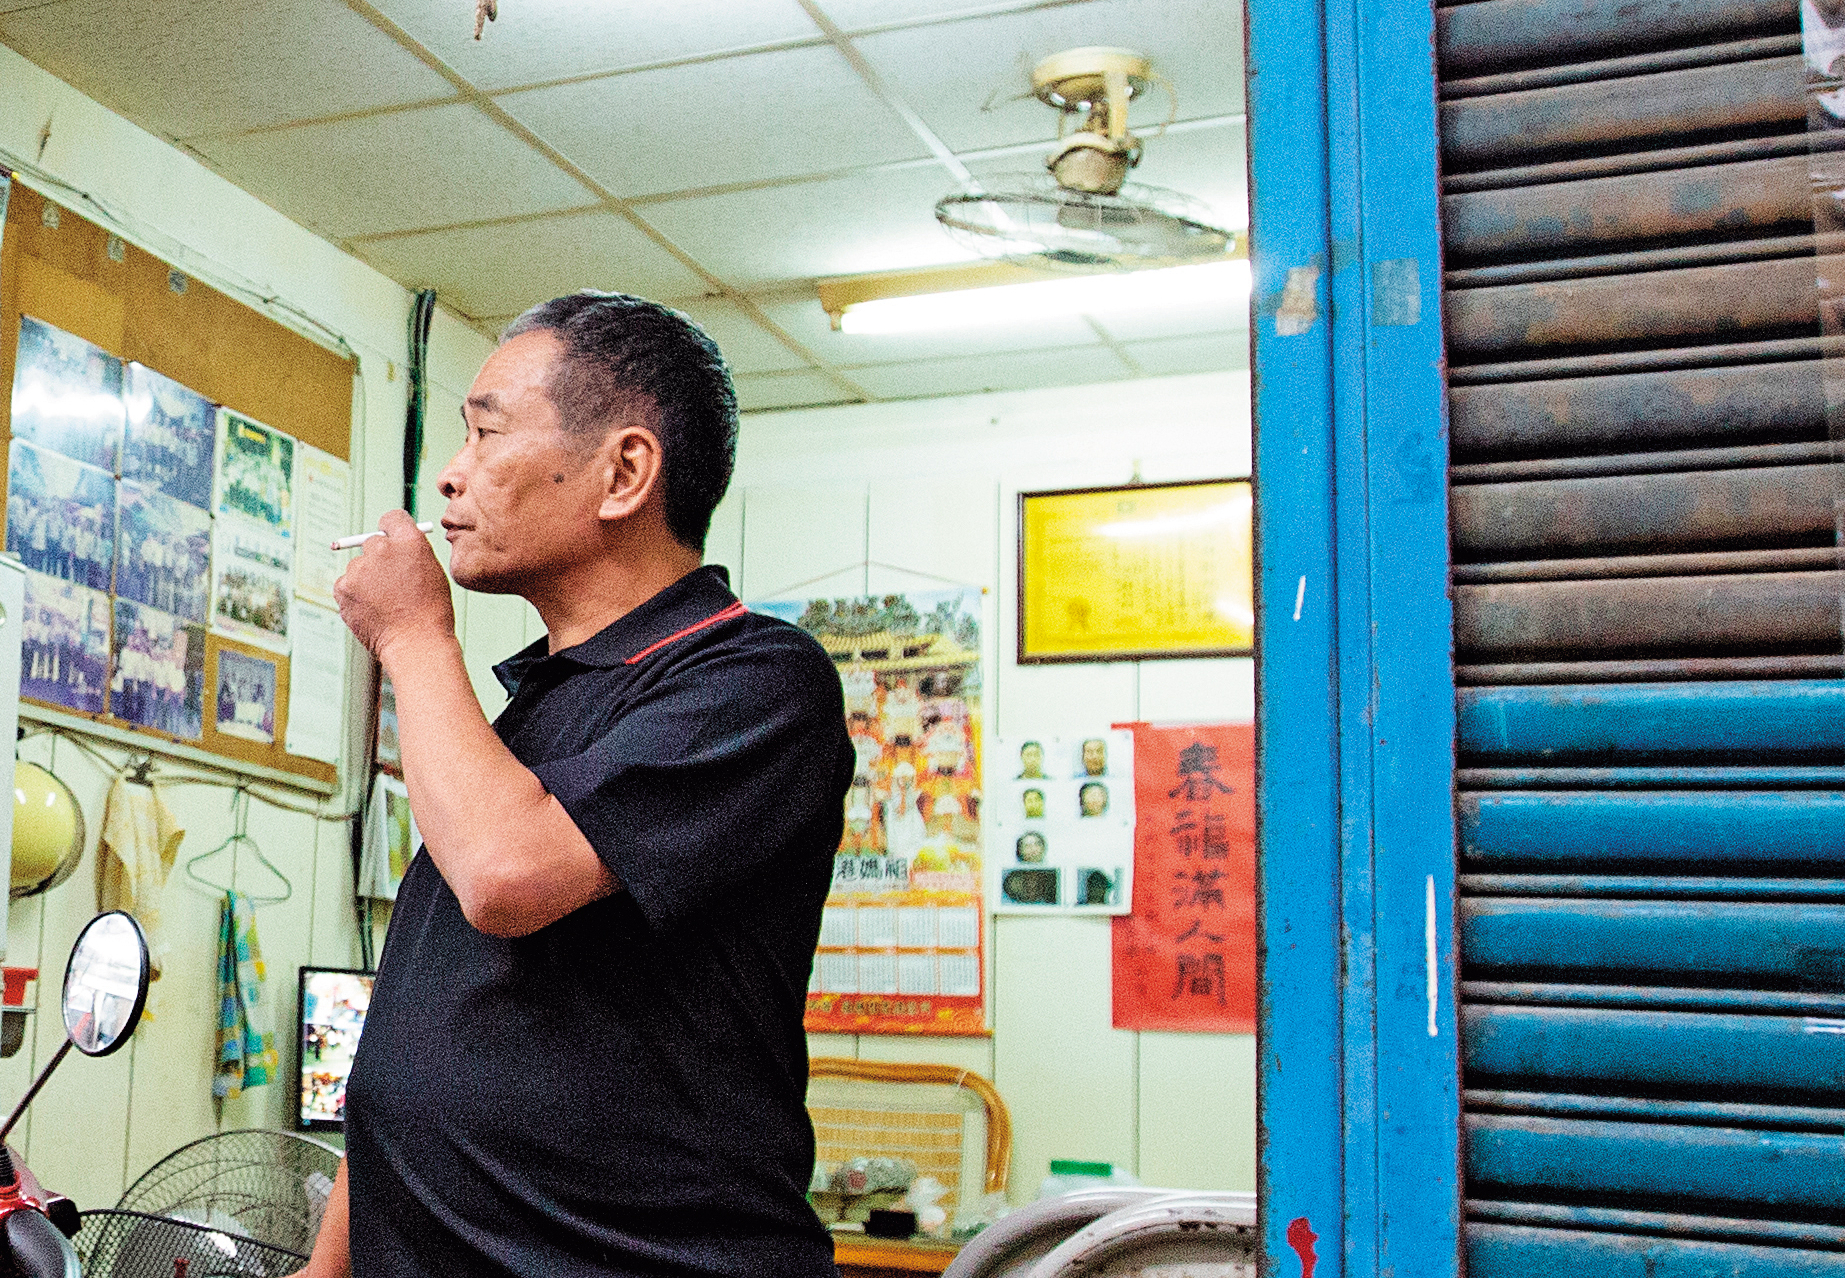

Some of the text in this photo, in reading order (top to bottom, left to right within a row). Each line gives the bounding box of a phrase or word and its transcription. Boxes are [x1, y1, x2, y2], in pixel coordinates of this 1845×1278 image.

[1167, 741, 1234, 1006] 春福滿人間
